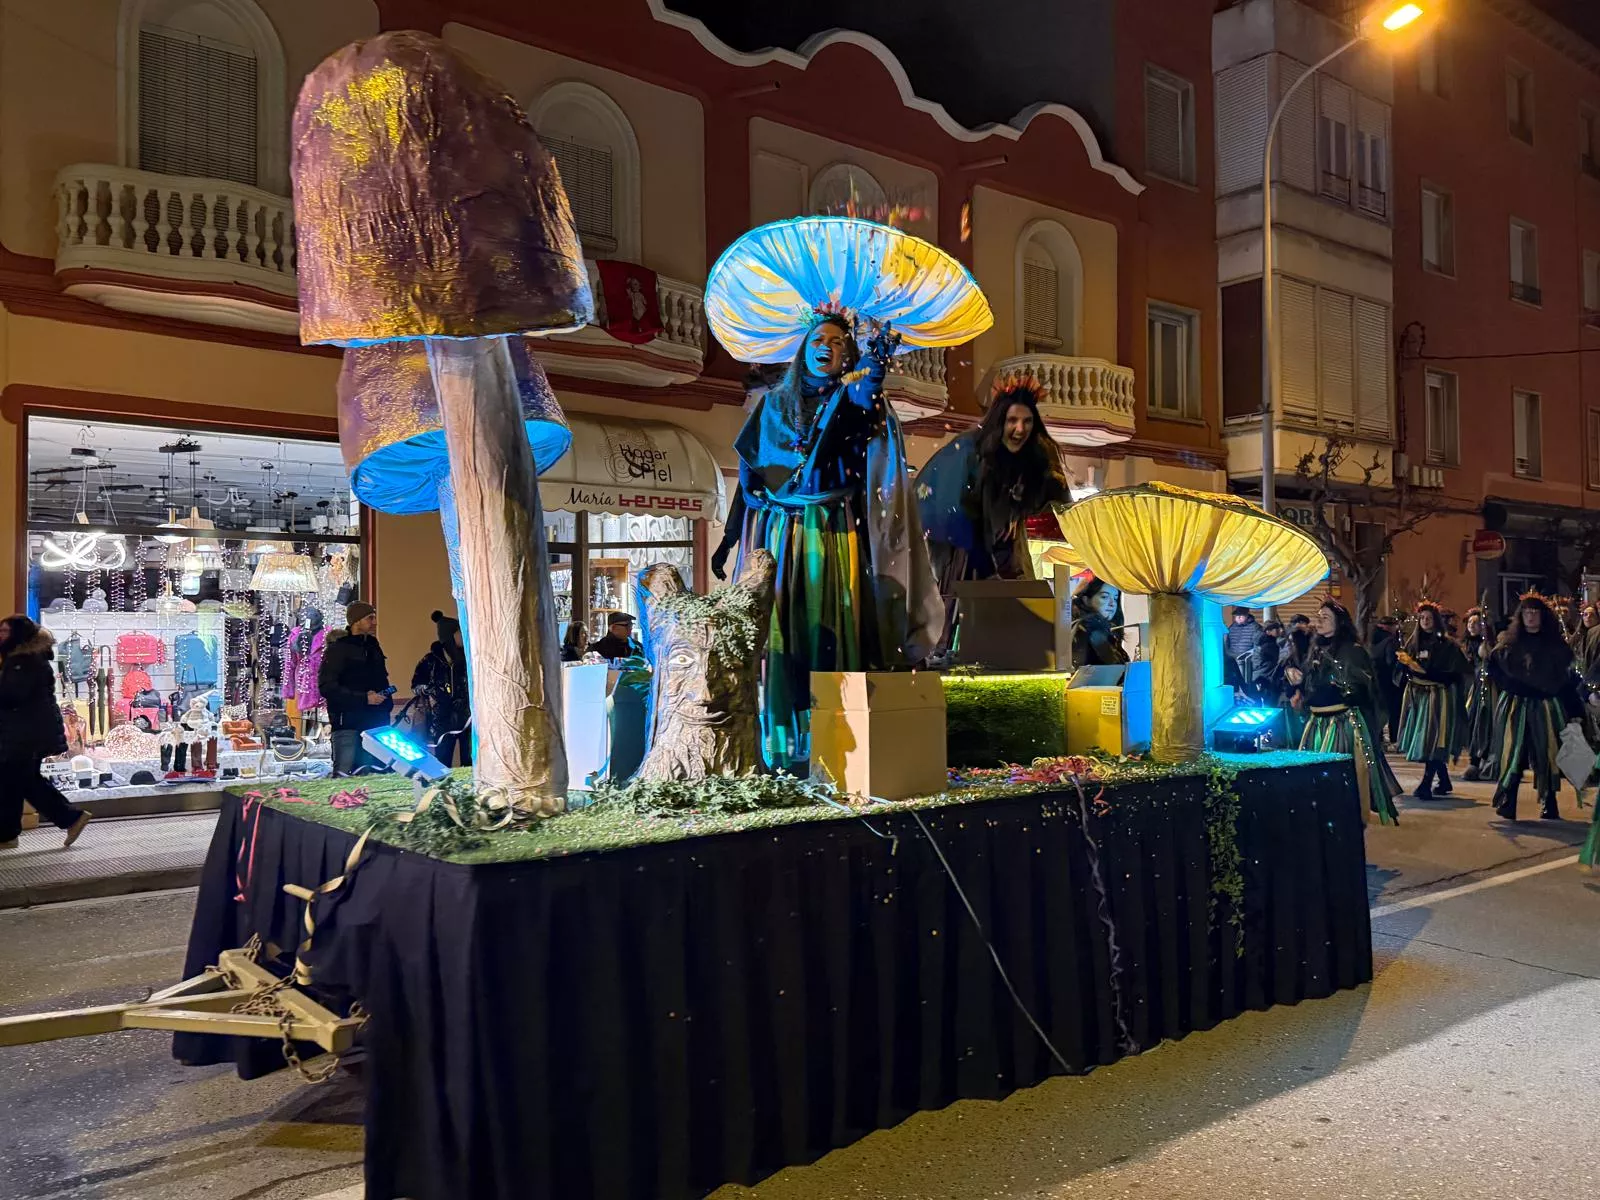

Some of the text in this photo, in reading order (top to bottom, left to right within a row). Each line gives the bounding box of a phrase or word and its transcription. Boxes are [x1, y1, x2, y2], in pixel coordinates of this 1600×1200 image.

[619, 443, 668, 464] Hogar
[641, 463, 673, 482] Piel
[564, 487, 616, 506] María
